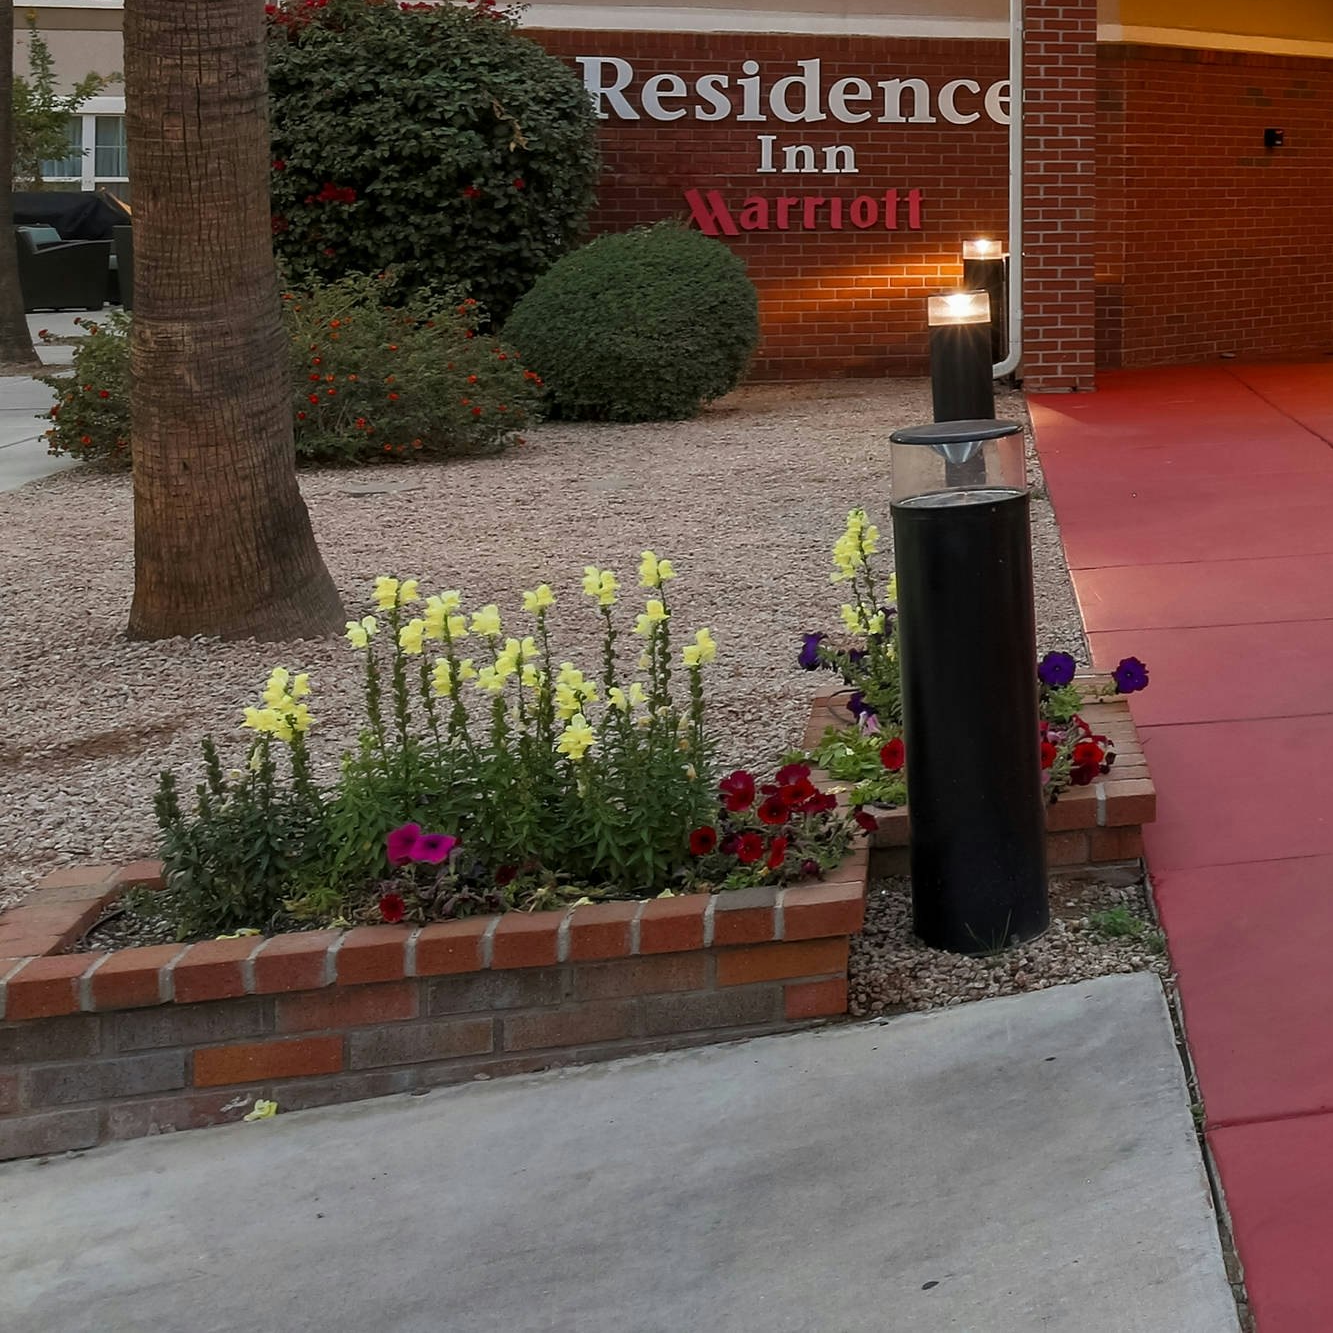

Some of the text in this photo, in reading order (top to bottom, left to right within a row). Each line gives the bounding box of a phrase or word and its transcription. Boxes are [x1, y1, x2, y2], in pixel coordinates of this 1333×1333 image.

[575, 55, 1011, 124] Residence
[756, 135, 859, 174] Inn
[684, 187, 922, 236] Marriott
